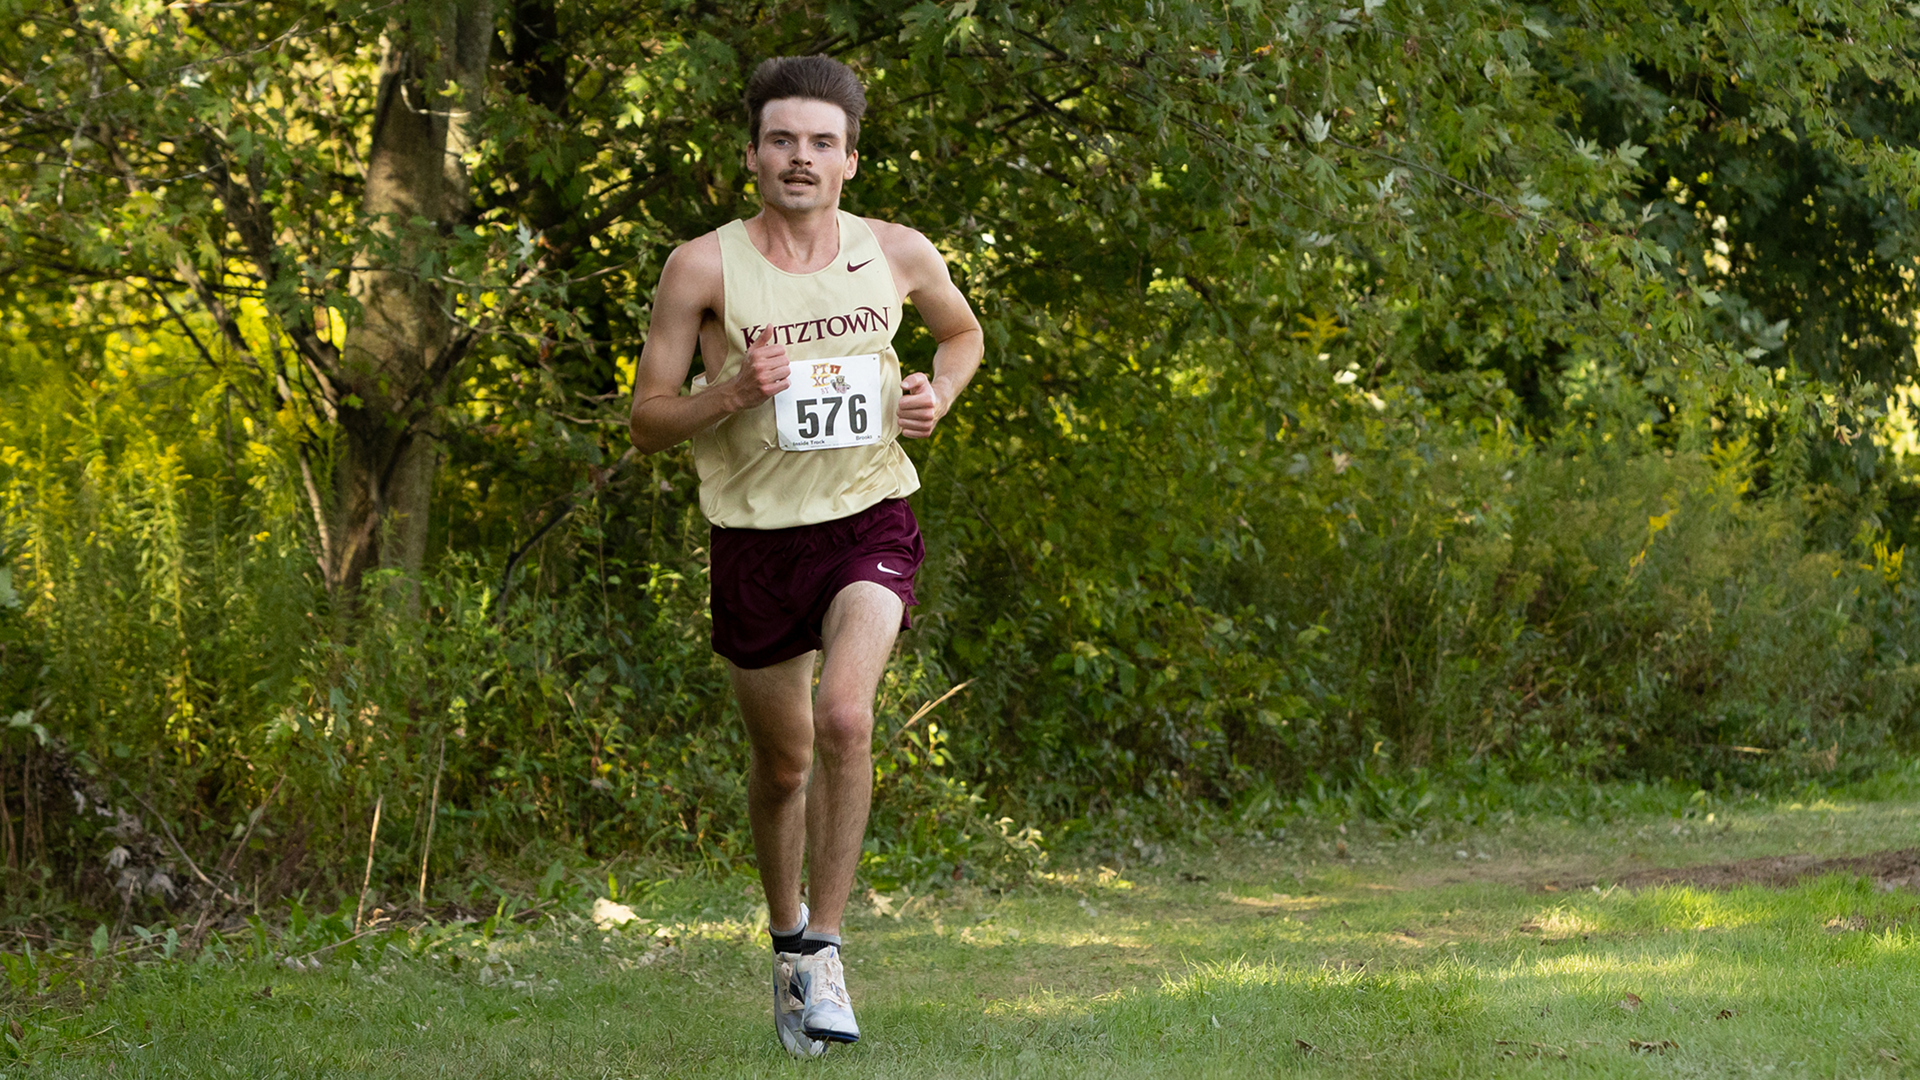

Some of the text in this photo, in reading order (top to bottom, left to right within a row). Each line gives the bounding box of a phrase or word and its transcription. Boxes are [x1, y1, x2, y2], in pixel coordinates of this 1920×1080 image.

[812, 364, 841, 376] PT 17
[811, 376, 830, 387] XC
[796, 394, 867, 438] 576
